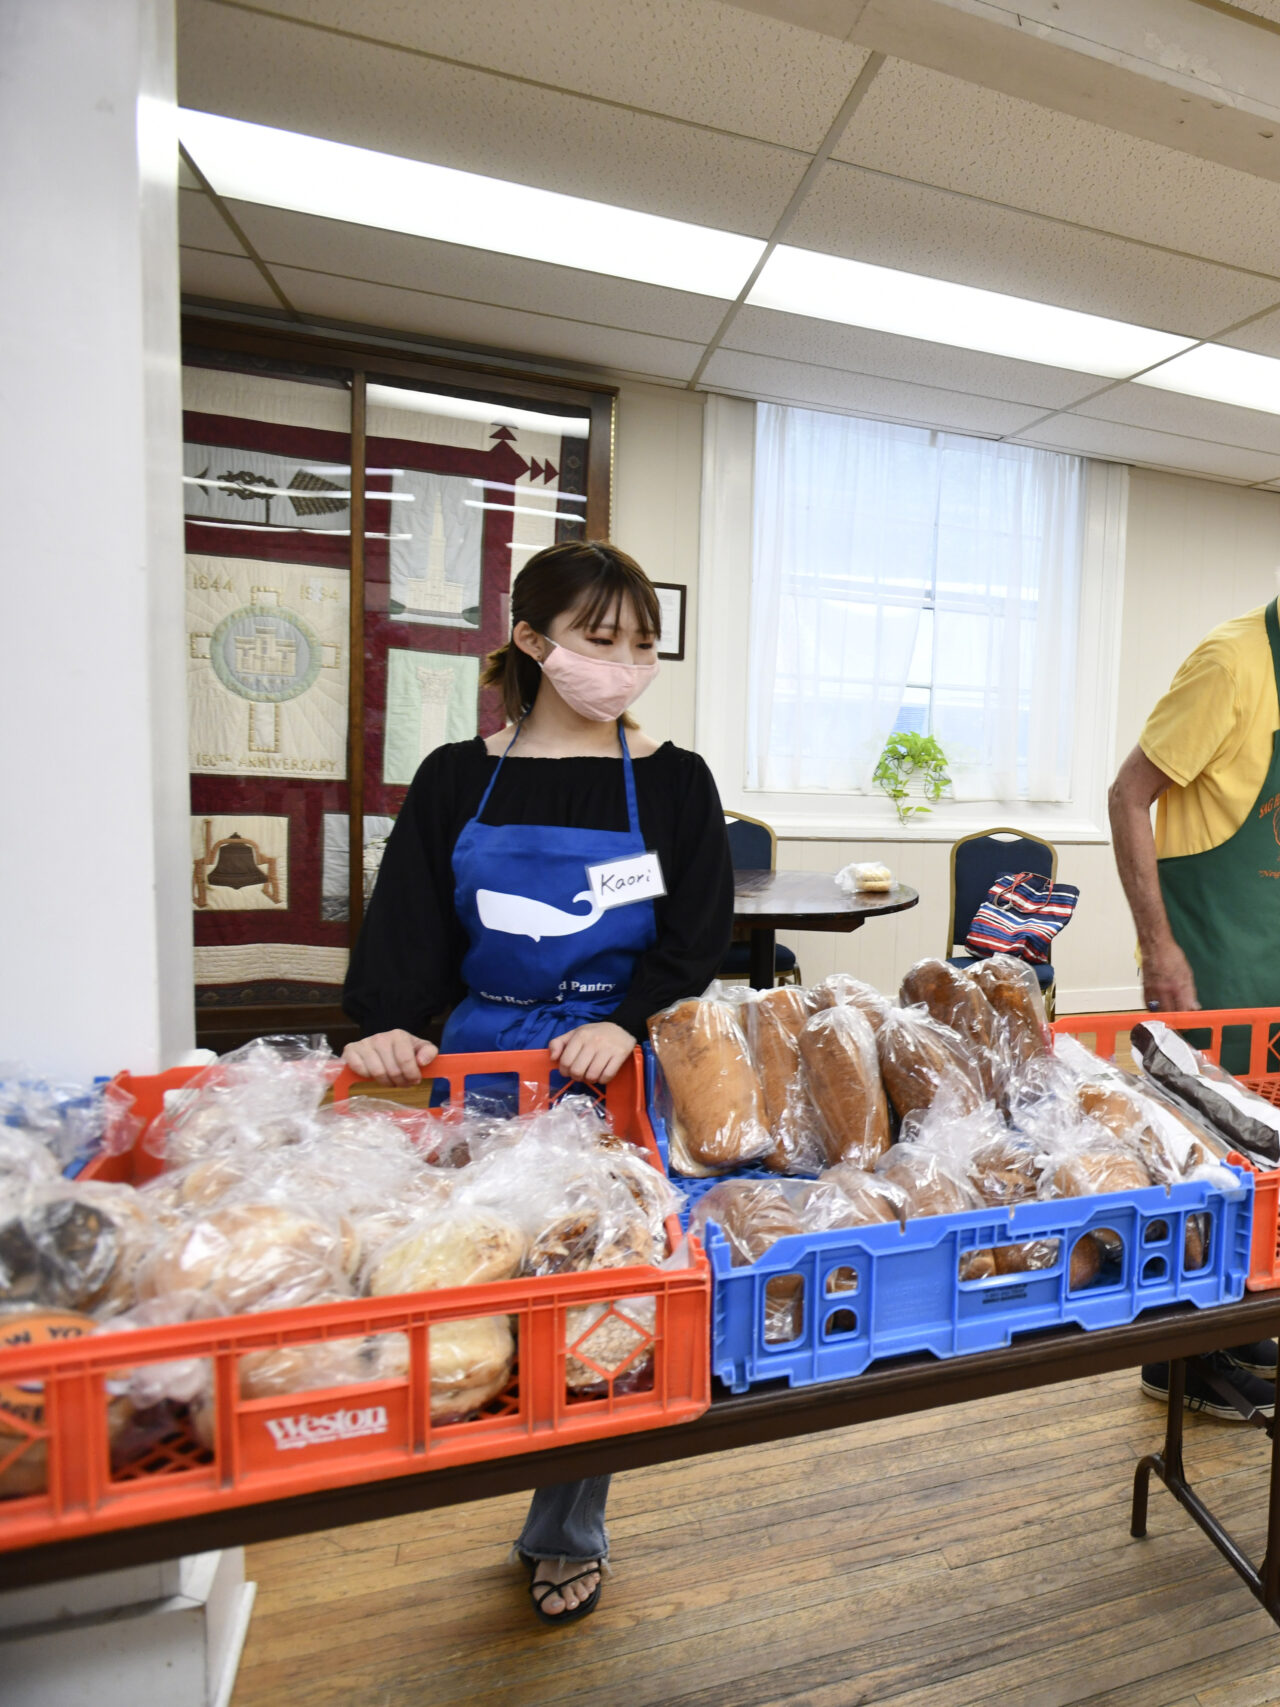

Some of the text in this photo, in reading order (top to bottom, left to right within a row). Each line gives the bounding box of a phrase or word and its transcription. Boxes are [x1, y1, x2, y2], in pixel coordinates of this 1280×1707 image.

[193, 573, 233, 593] 1844
[601, 869, 651, 896] Kaori
[571, 981, 616, 992] Pantry
[264, 1406, 388, 1441] Weston
